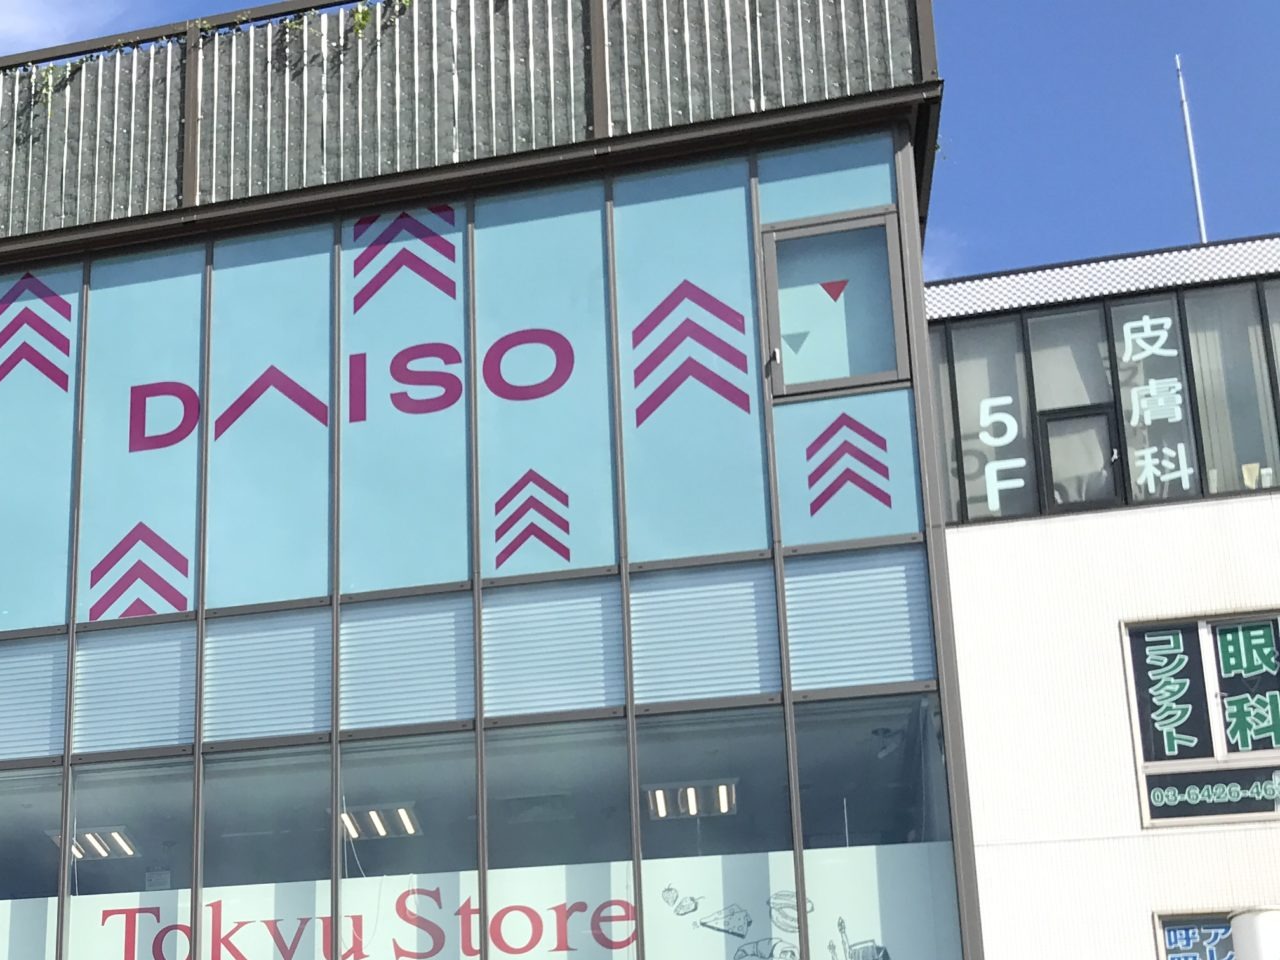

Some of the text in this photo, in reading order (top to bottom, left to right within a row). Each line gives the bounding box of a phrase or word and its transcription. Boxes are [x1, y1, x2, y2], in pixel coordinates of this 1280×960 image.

[129, 328, 575, 452] DAISO
[1122, 315, 1194, 494] 皮膚科
[1144, 630, 1198, 756] コンタクト
[1216, 622, 1280, 751] 眼科
[1150, 780, 1280, 807] 03-6426-46
[392, 887, 638, 960] Store
